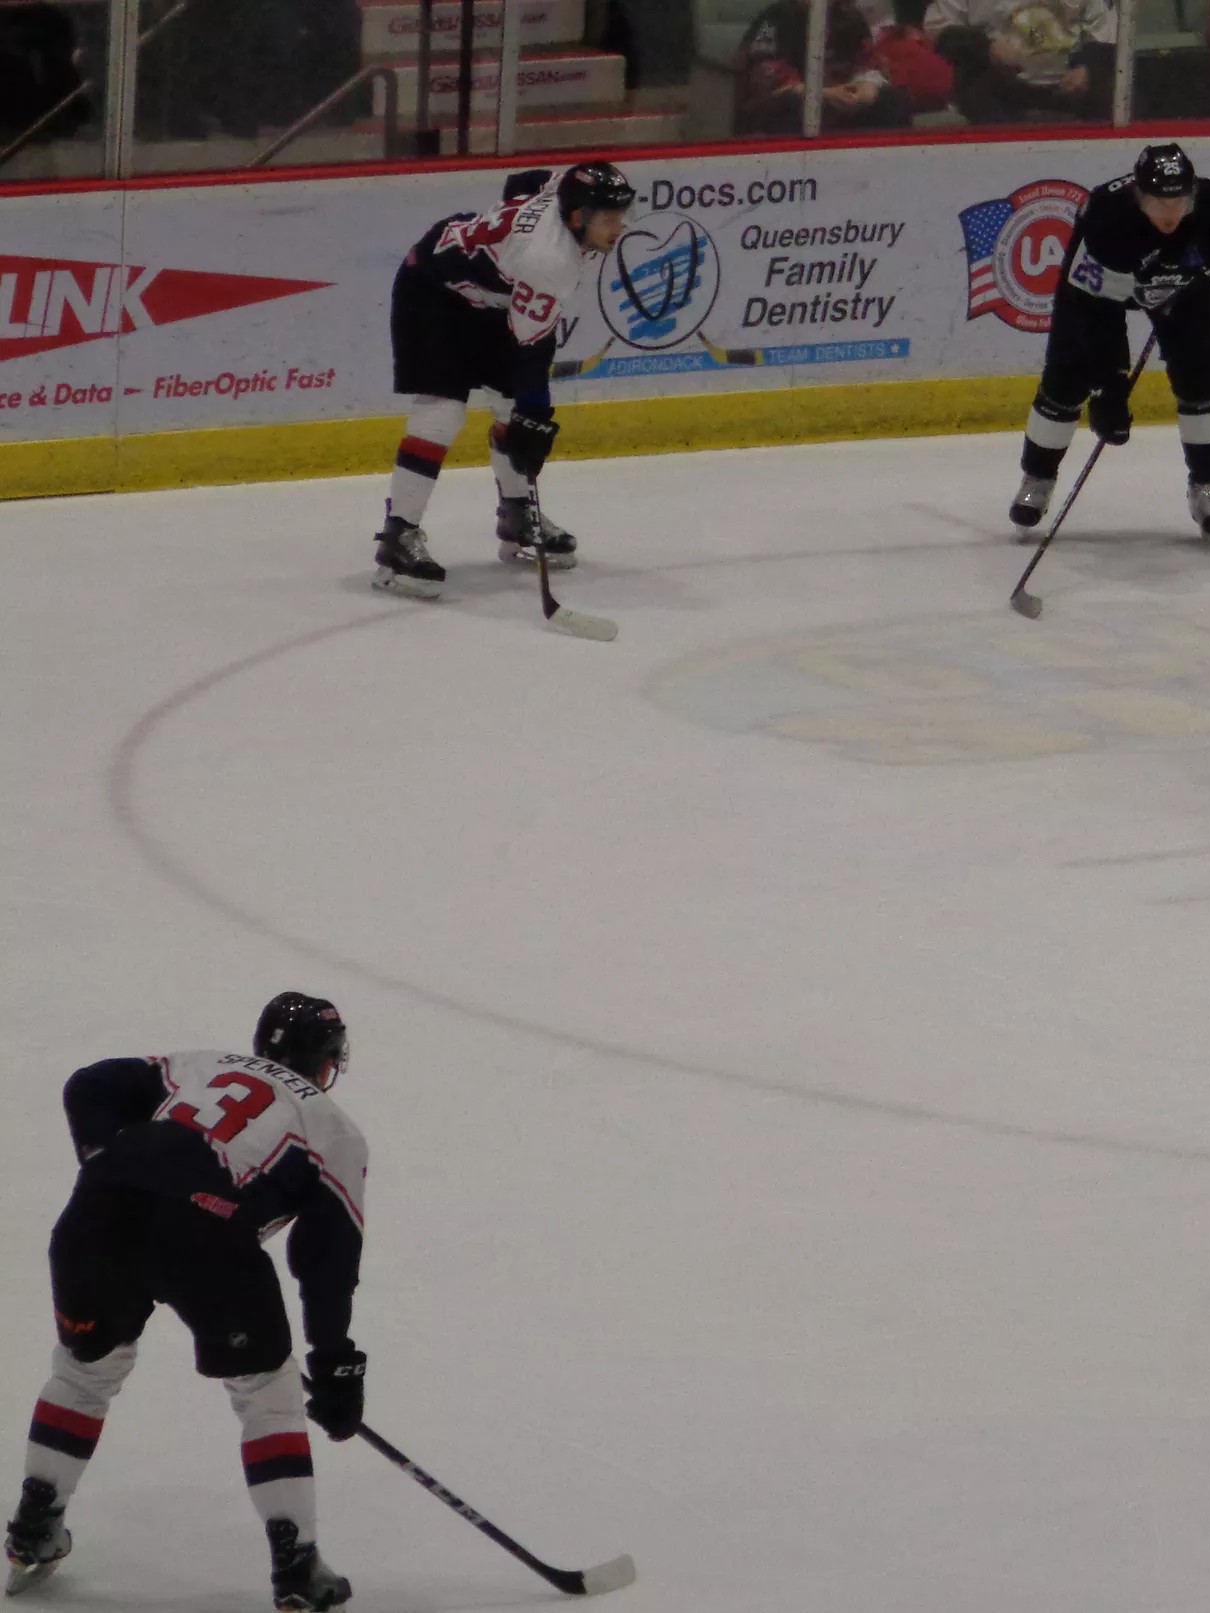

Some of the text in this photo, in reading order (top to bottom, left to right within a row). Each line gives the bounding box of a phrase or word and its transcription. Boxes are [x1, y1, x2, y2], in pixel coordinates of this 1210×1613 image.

[741, 220, 906, 251] Queensbury
[764, 252, 878, 290] Family
[1021, 235, 1066, 276] UA
[512, 281, 556, 323] 23
[741, 292, 896, 328] Dentistry
[608, 354, 704, 377] ADIRONDACK
[769, 343, 886, 363] TEAM DENTISTS
[54, 383, 113, 405] Data
[153, 370, 278, 400] FiberOptic
[285, 368, 336, 390] Fast
[217, 1053, 318, 1101] SPENCER
[169, 1072, 276, 1144] 3
[333, 1364, 367, 1378] CC
